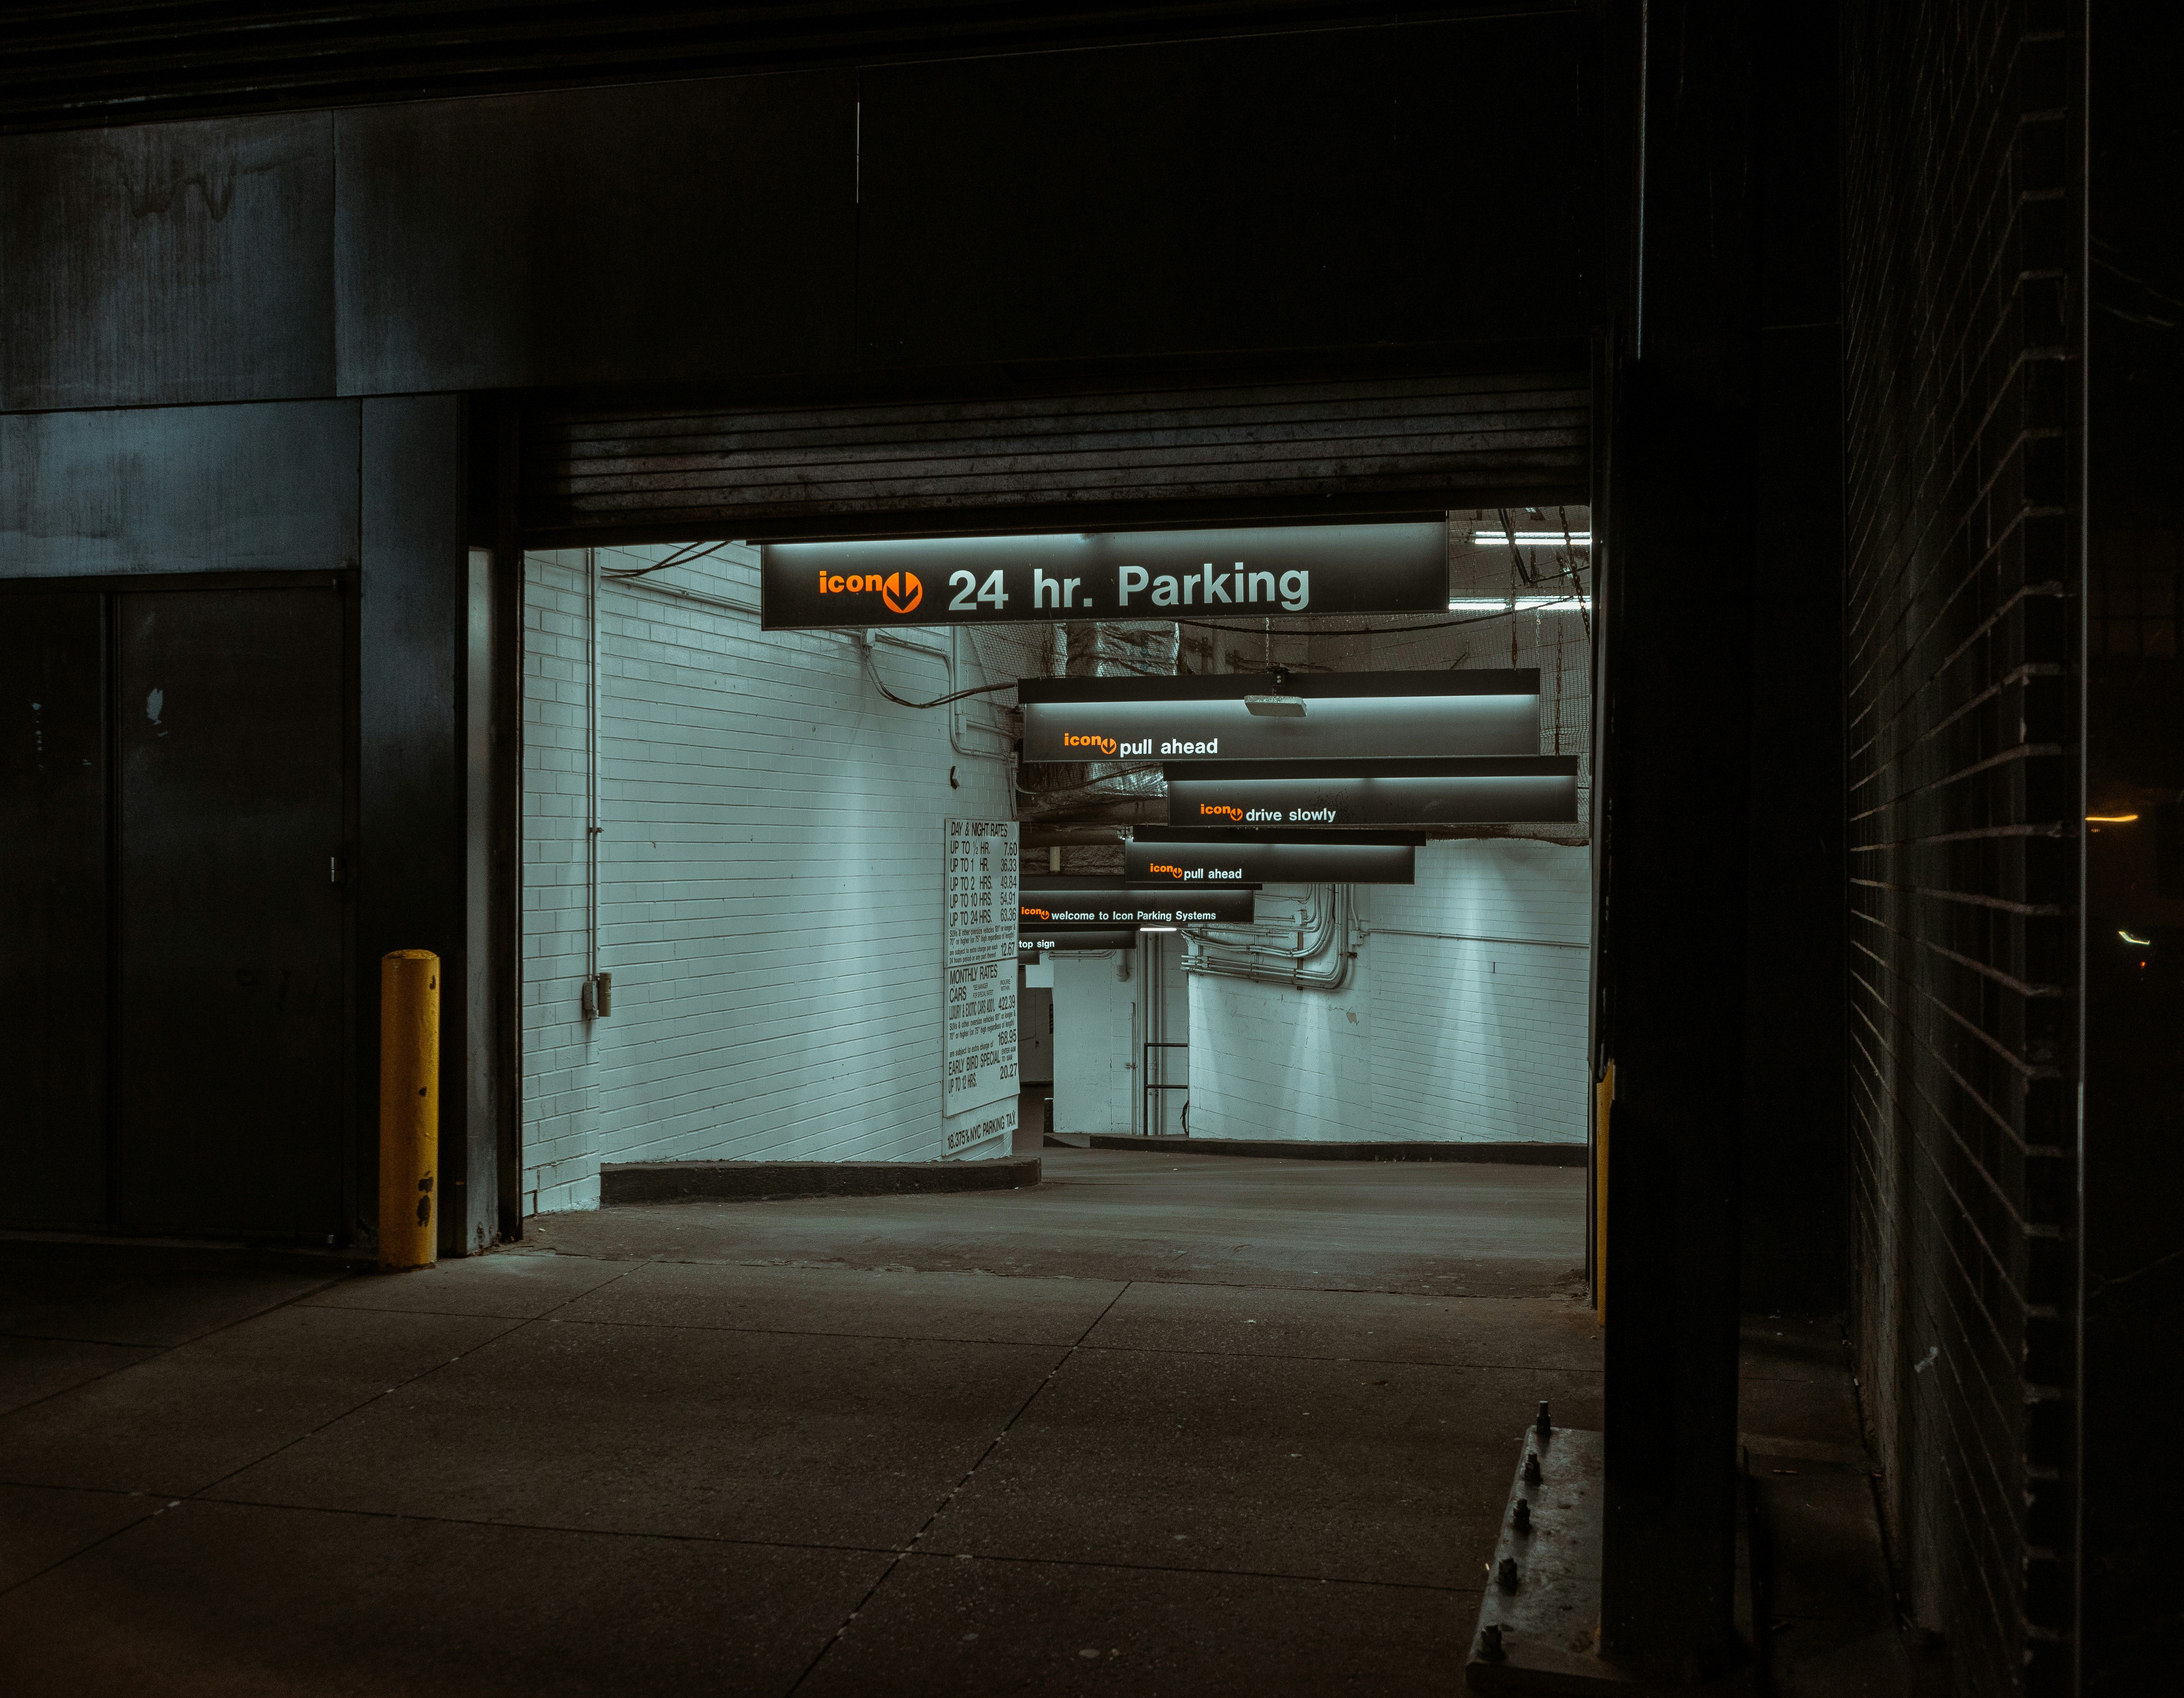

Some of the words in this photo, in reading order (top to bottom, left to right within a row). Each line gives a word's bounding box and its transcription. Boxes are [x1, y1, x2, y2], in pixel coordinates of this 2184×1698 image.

[820, 571, 883, 593] icon
[949, 570, 1008, 610] 24
[1034, 568, 1092, 607] hr.
[1119, 562, 1308, 611] Parking
[1065, 733, 1101, 746] icon
[1120, 739, 1152, 757] pull
[1161, 738, 1218, 754] ahead
[1201, 804, 1230, 814] icon
[1246, 809, 1282, 821] drive
[1289, 808, 1336, 822] slowly
[951, 822, 963, 836] DAY
[965, 822, 969, 836] &
[972, 822, 989, 836] NIGHT
[991, 823, 1008, 837] RATES
[950, 840, 959, 854] UP
[962, 841, 970, 854] TO
[981, 842, 990, 854] HR.
[1004, 842, 1017, 856] 7.60
[950, 858, 958, 872] UP
[960, 858, 969, 872] TO
[971, 858, 973, 872] 1
[980, 858, 989, 871] HR.
[1001, 858, 1016, 872] 36.33
[1151, 864, 1173, 872] icon
[1184, 869, 1203, 881] pull
[1208, 869, 1241, 879] ahead
[950, 877, 958, 891] UP
[960, 876, 969, 891] TO
[971, 876, 975, 890] 2
[980, 875, 992, 890] HRS.
[1001, 875, 1016, 889] 49.84
[950, 894, 958, 909] UP
[960, 893, 968, 908] TO
[971, 892, 977, 907] 10
[980, 892, 992, 906] HRS.
[1000, 892, 1015, 905] 54.91
[950, 912, 958, 927] UP
[960, 911, 968, 926] TO
[970, 910, 978, 924] 24
[979, 909, 992, 924] HRS.
[1001, 908, 1016, 922] 63.36
[1051, 911, 1095, 920] welcome
[1113, 911, 1133, 920] Icon
[1137, 911, 1171, 921] Parking
[1176, 911, 1216, 921] Systems
[960, 937, 969, 945] higher
[987, 933, 1001, 942] regardless
[1019, 941, 1033, 949] top
[1037, 940, 1055, 949] sign
[1001, 942, 1015, 956] 12.67
[950, 967, 978, 985] MONTHLY
[980, 964, 998, 980] RATES
[950, 986, 966, 1003] CARS
[949, 1004, 961, 1020] LUXURY
[962, 1004, 964, 1018] &
[966, 1001, 976, 1017] EXOTIC
[998, 994, 1015, 1011] 422.39
[970, 1018, 982, 1026] oversize
[983, 1015, 994, 1023] vehicles
[960, 1030, 969, 1039] higher
[987, 1023, 1001, 1033] regardless
[998, 1029, 1016, 1046] 168.95
[956, 1047, 966, 1057] subject
[948, 1058, 964, 1076] EARLY
[966, 1055, 978, 1071] BIRD
[980, 1050, 1000, 1068] SPECIAL
[1000, 1063, 1017, 1080] 20.27
[948, 1079, 954, 1093] UP
[955, 1076, 960, 1091] TO
[962, 1074, 966, 1090] 12
[968, 1072, 977, 1088] HRS.
[970, 1124, 981, 1142] NYC
[983, 1115, 1004, 1137] PARKING
[1006, 1111, 1015, 1127] TAX
